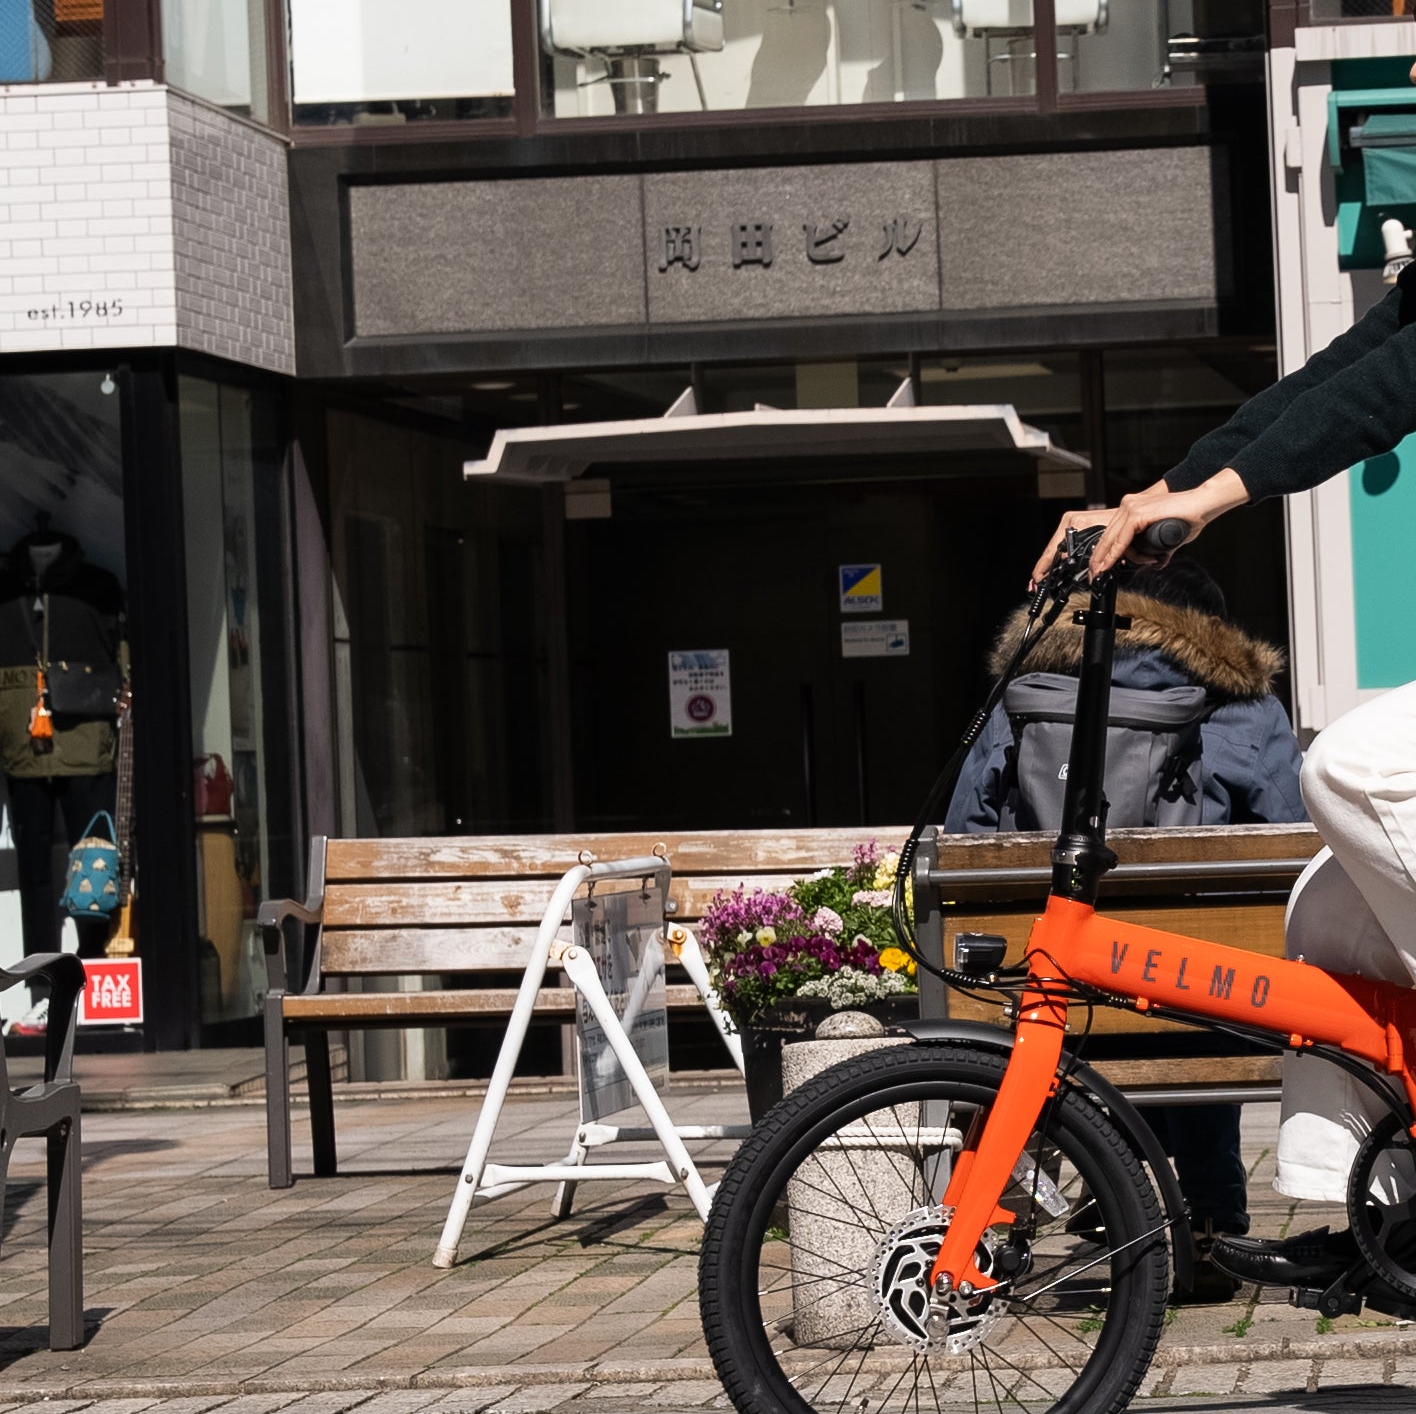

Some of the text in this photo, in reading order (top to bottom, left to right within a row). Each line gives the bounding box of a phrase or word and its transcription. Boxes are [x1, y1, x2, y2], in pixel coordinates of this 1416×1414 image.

[27, 297, 124, 321] est.1985
[90, 973, 131, 992] TAX
[1110, 940, 1271, 1009] VELMO
[91, 990, 132, 1009] FREE
